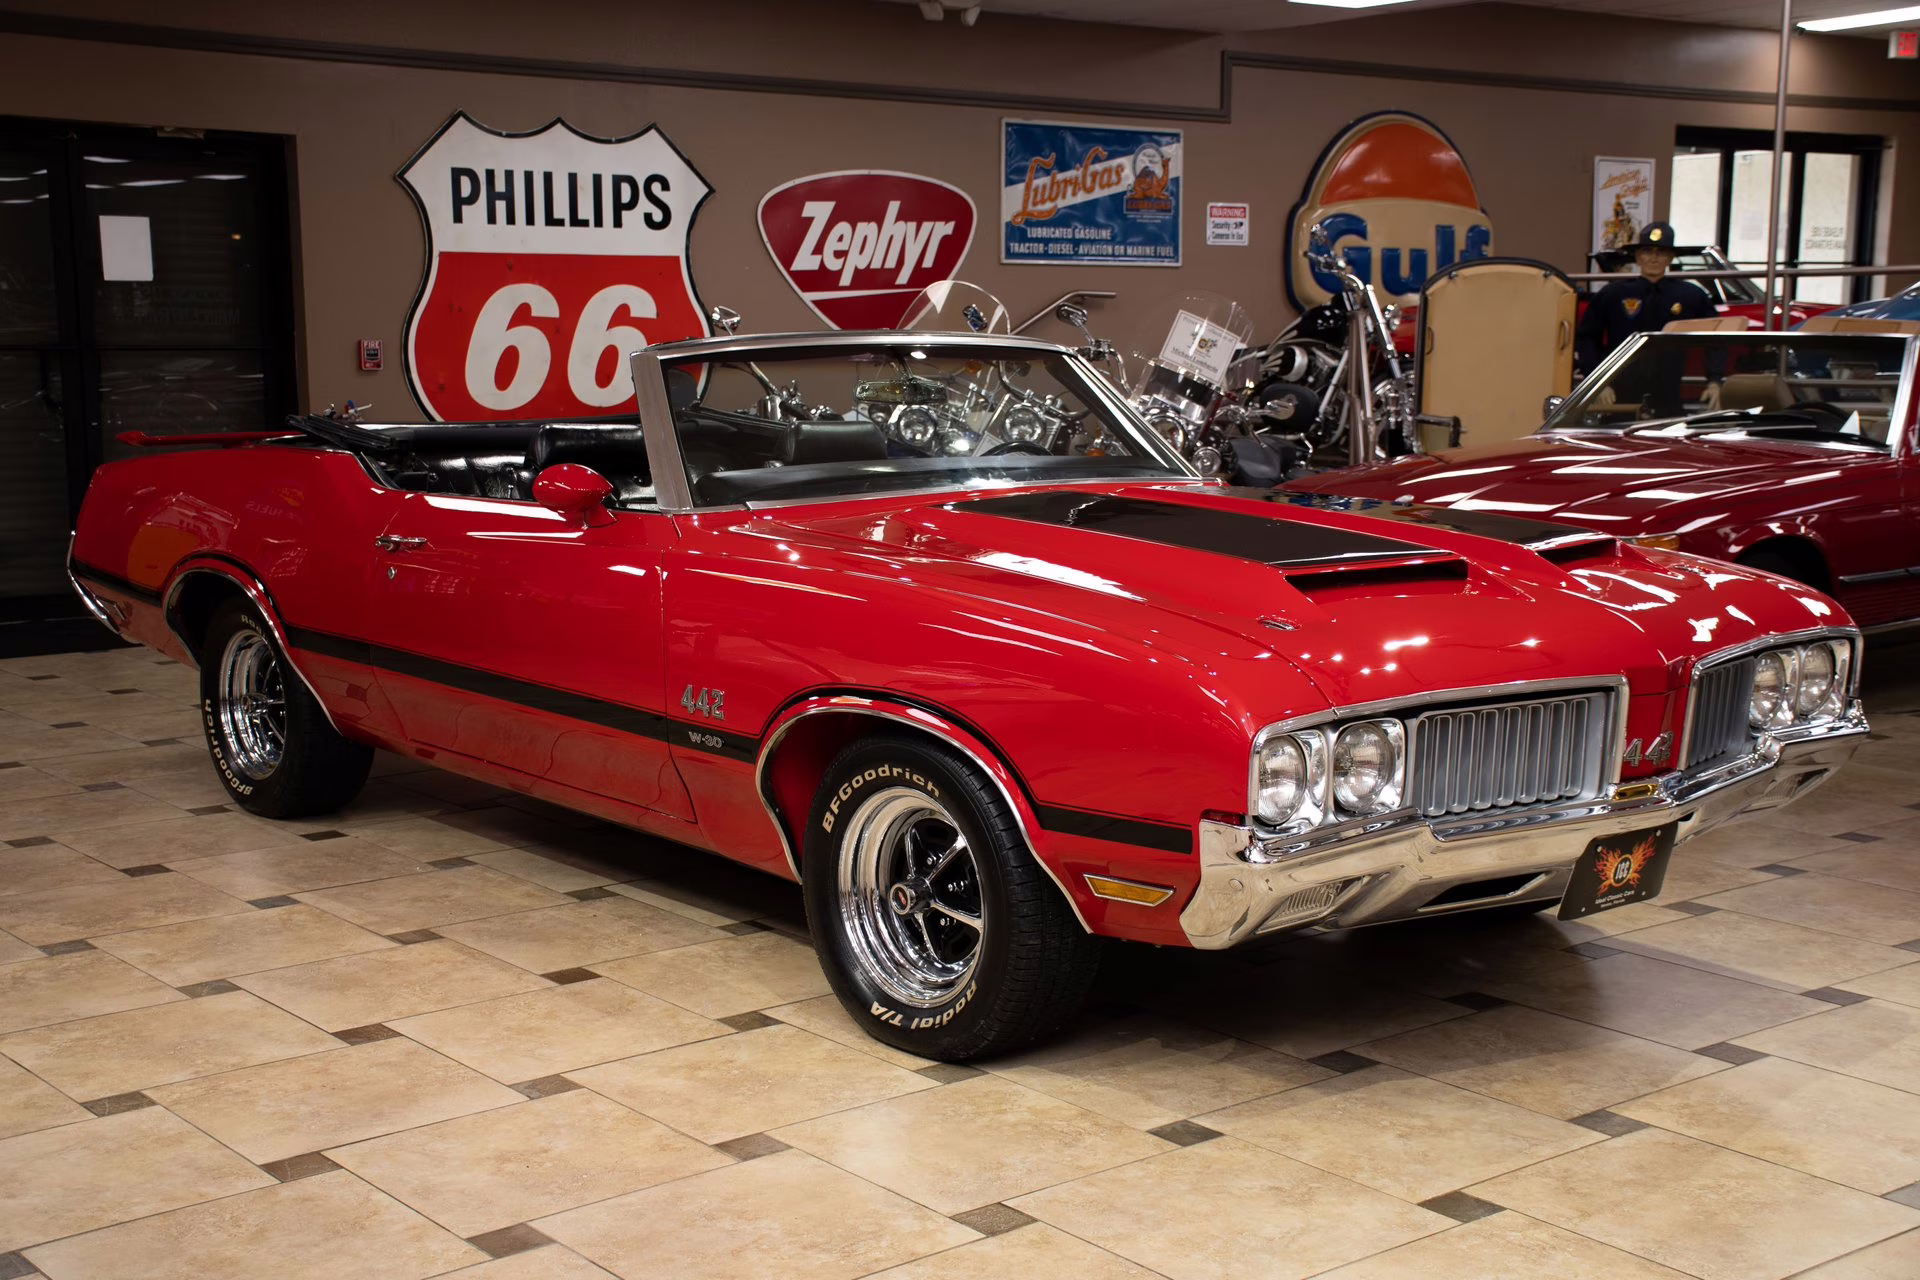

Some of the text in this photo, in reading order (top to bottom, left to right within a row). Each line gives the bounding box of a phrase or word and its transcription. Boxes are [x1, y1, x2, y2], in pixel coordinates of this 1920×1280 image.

[450, 166, 673, 231] PHILLIPS
[1211, 208, 1245, 218] WARNING
[790, 200, 956, 287] Zephyr
[1027, 227, 1112, 240] LUBRICATED GASOLINE
[1114, 245, 1125, 256] OR
[1126, 245, 1156, 256] MARINE
[1156, 246, 1175, 257] FUEL
[465, 282, 658, 411] 66
[681, 684, 725, 720] 442
[204, 698, 254, 796] BFGoodrich
[688, 731, 723, 749] W-30
[822, 763, 940, 833] BFGoodrich
[870, 979, 977, 1030] Radial T/A
